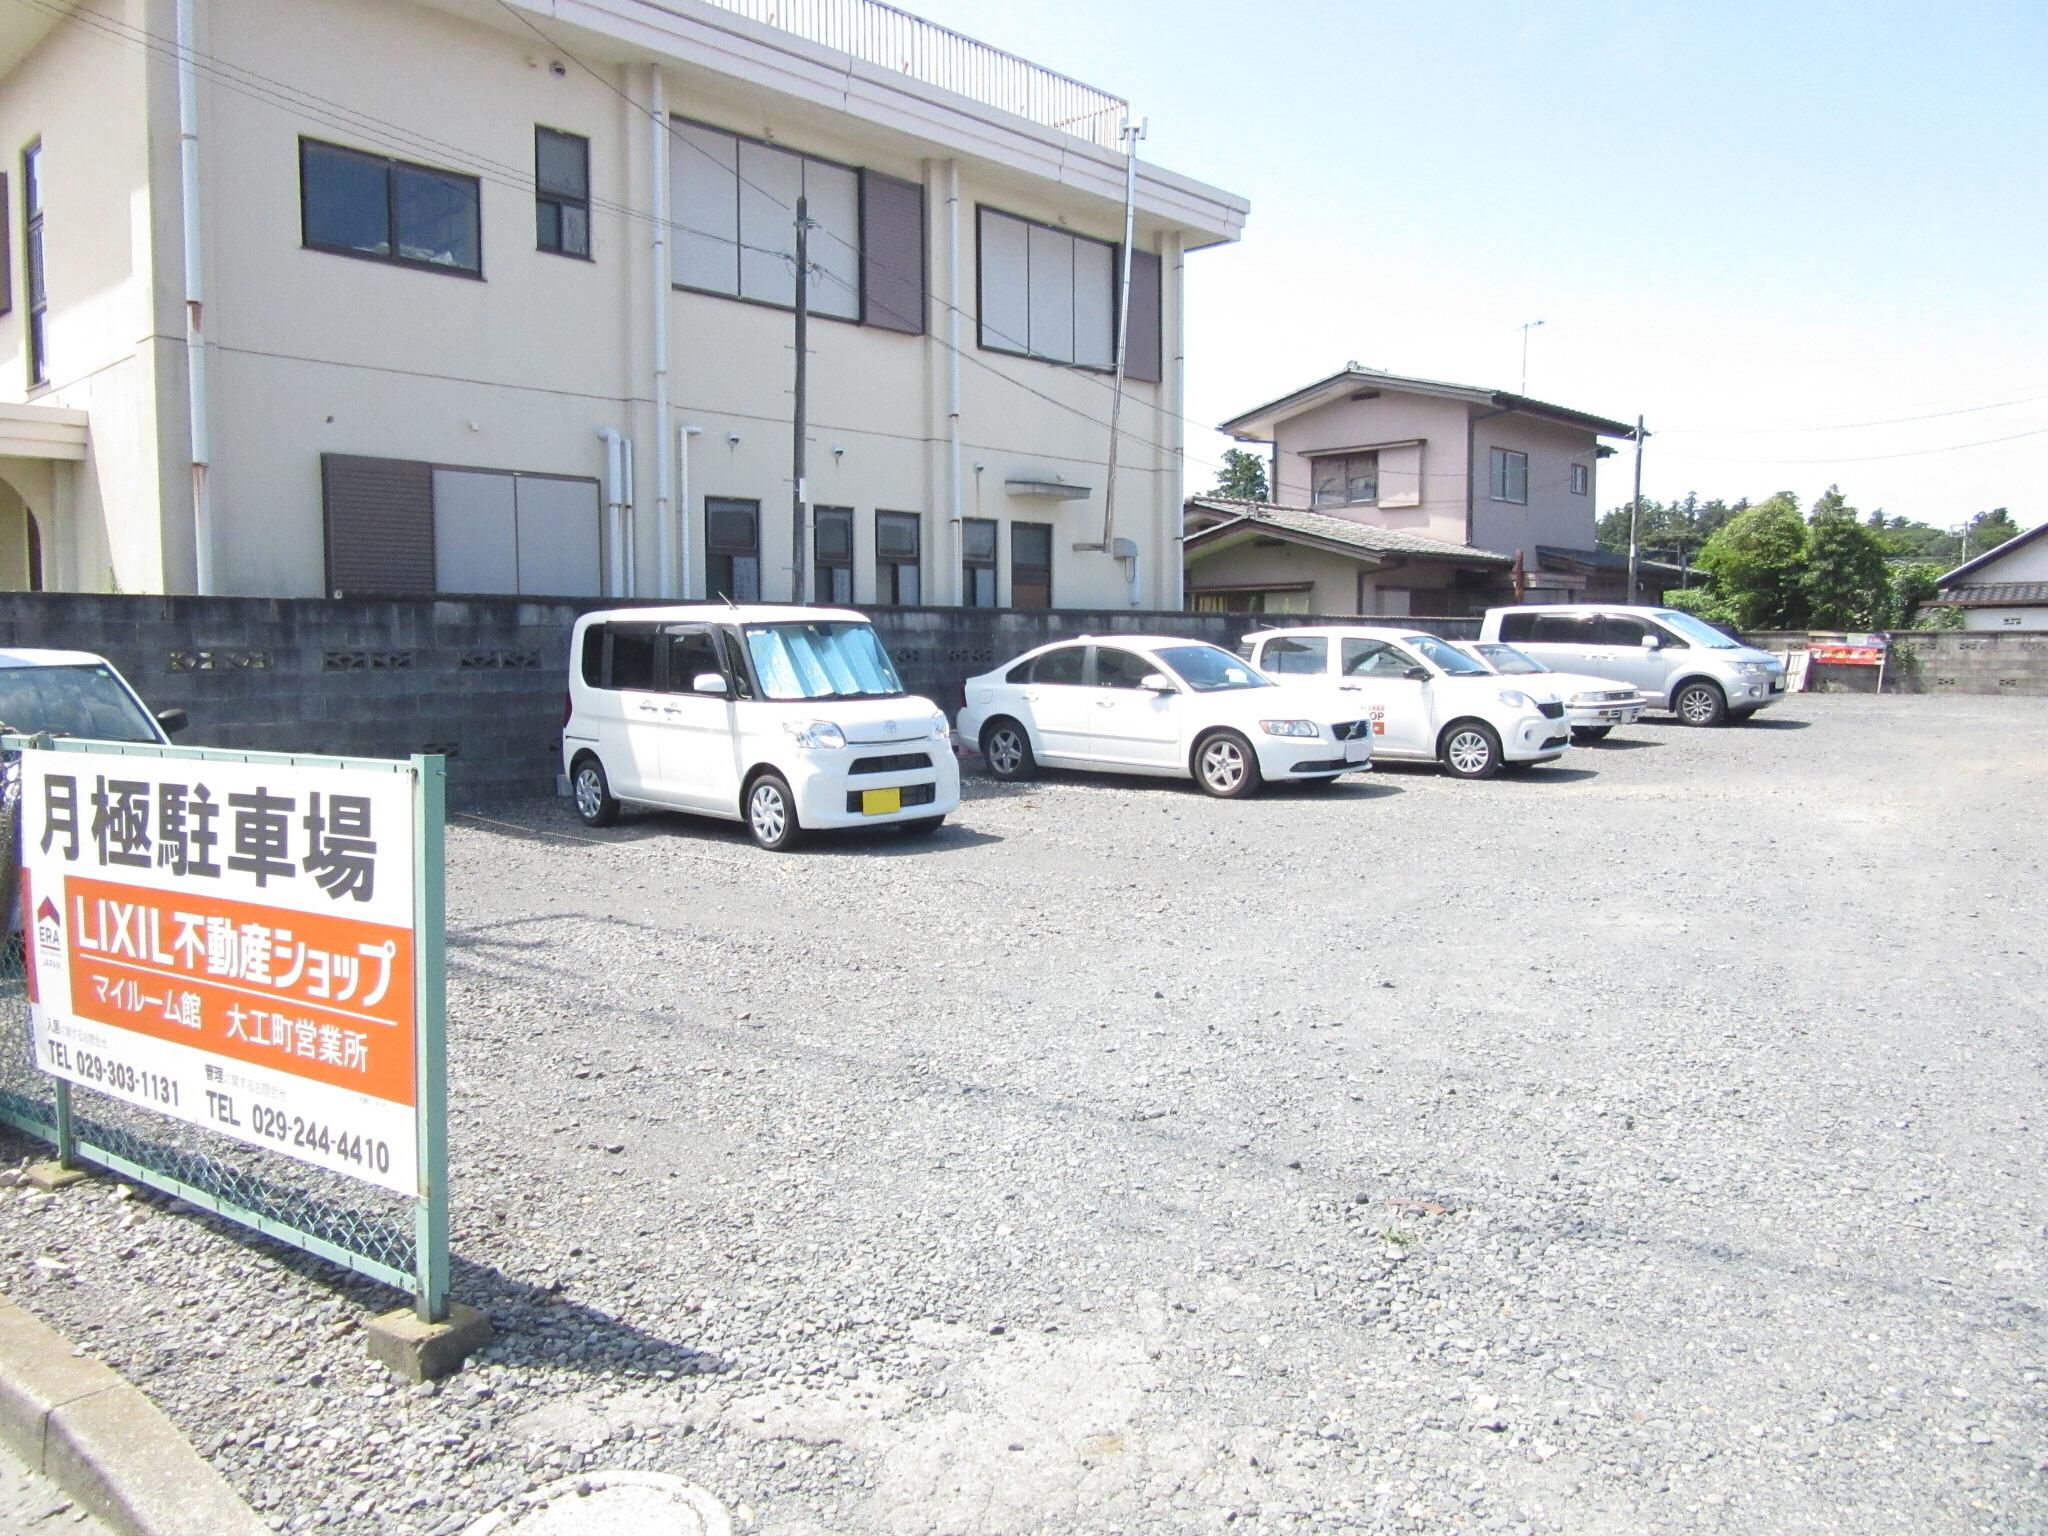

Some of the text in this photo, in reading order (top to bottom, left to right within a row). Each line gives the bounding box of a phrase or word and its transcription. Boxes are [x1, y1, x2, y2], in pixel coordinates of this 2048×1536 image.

[40, 773, 378, 903] 月極駐車場
[39, 926, 60, 946] ERA
[77, 895, 396, 1007] LIXIL不動産ショップ
[92, 975, 369, 1073] マイルーム館 大工町営業所
[48, 1039, 179, 1107] TEL 029-303-1131
[205, 1090, 390, 1174] TEL 029-244-4410
